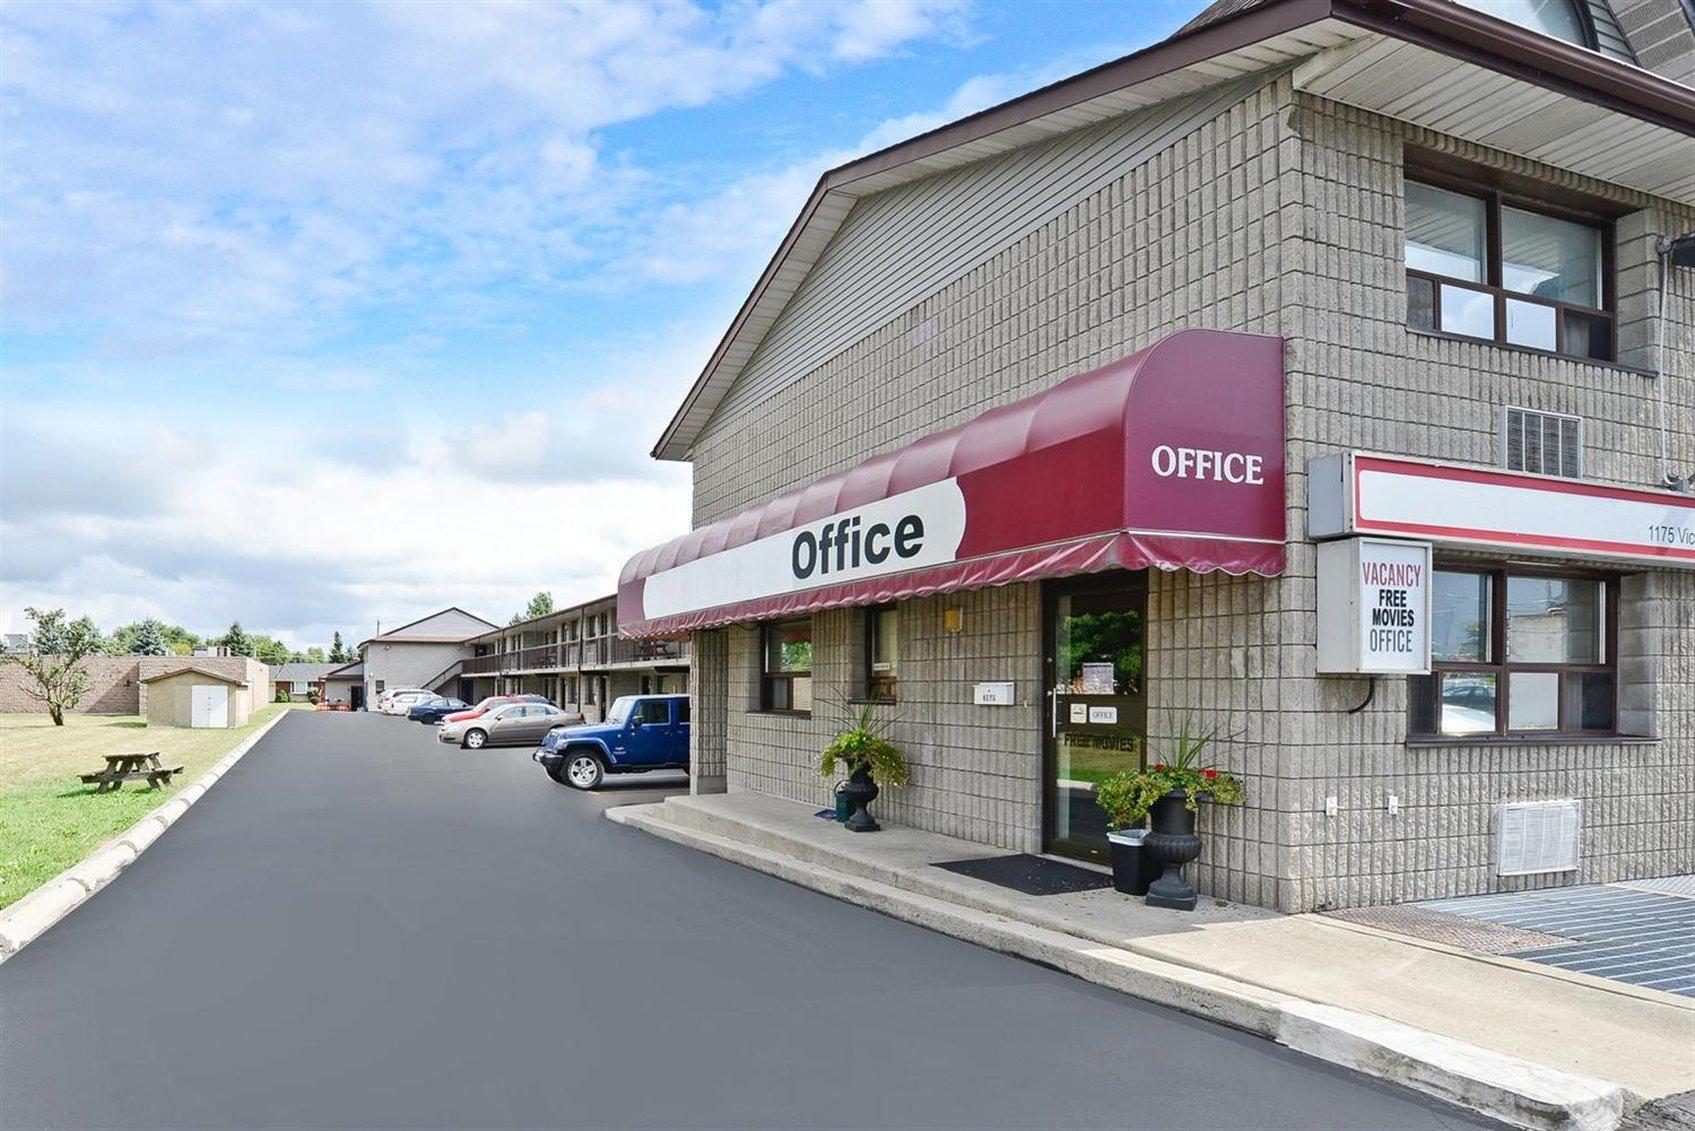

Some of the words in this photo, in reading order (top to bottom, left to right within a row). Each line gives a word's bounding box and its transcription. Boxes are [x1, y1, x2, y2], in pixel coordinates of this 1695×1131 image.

[1152, 445, 1264, 485] OFFICE
[1649, 525, 1674, 543] 1175
[1677, 526, 1695, 545] Vic
[792, 515, 924, 580] Office
[1362, 562, 1421, 587] VACANCY
[1379, 589, 1407, 607] FREE
[1372, 608, 1415, 627] MOVIES
[1370, 628, 1413, 652] OFFICE
[1092, 711, 1113, 719] OFFICE
[1064, 733, 1091, 748] FREE
[1092, 735, 1134, 752] MOVIES
